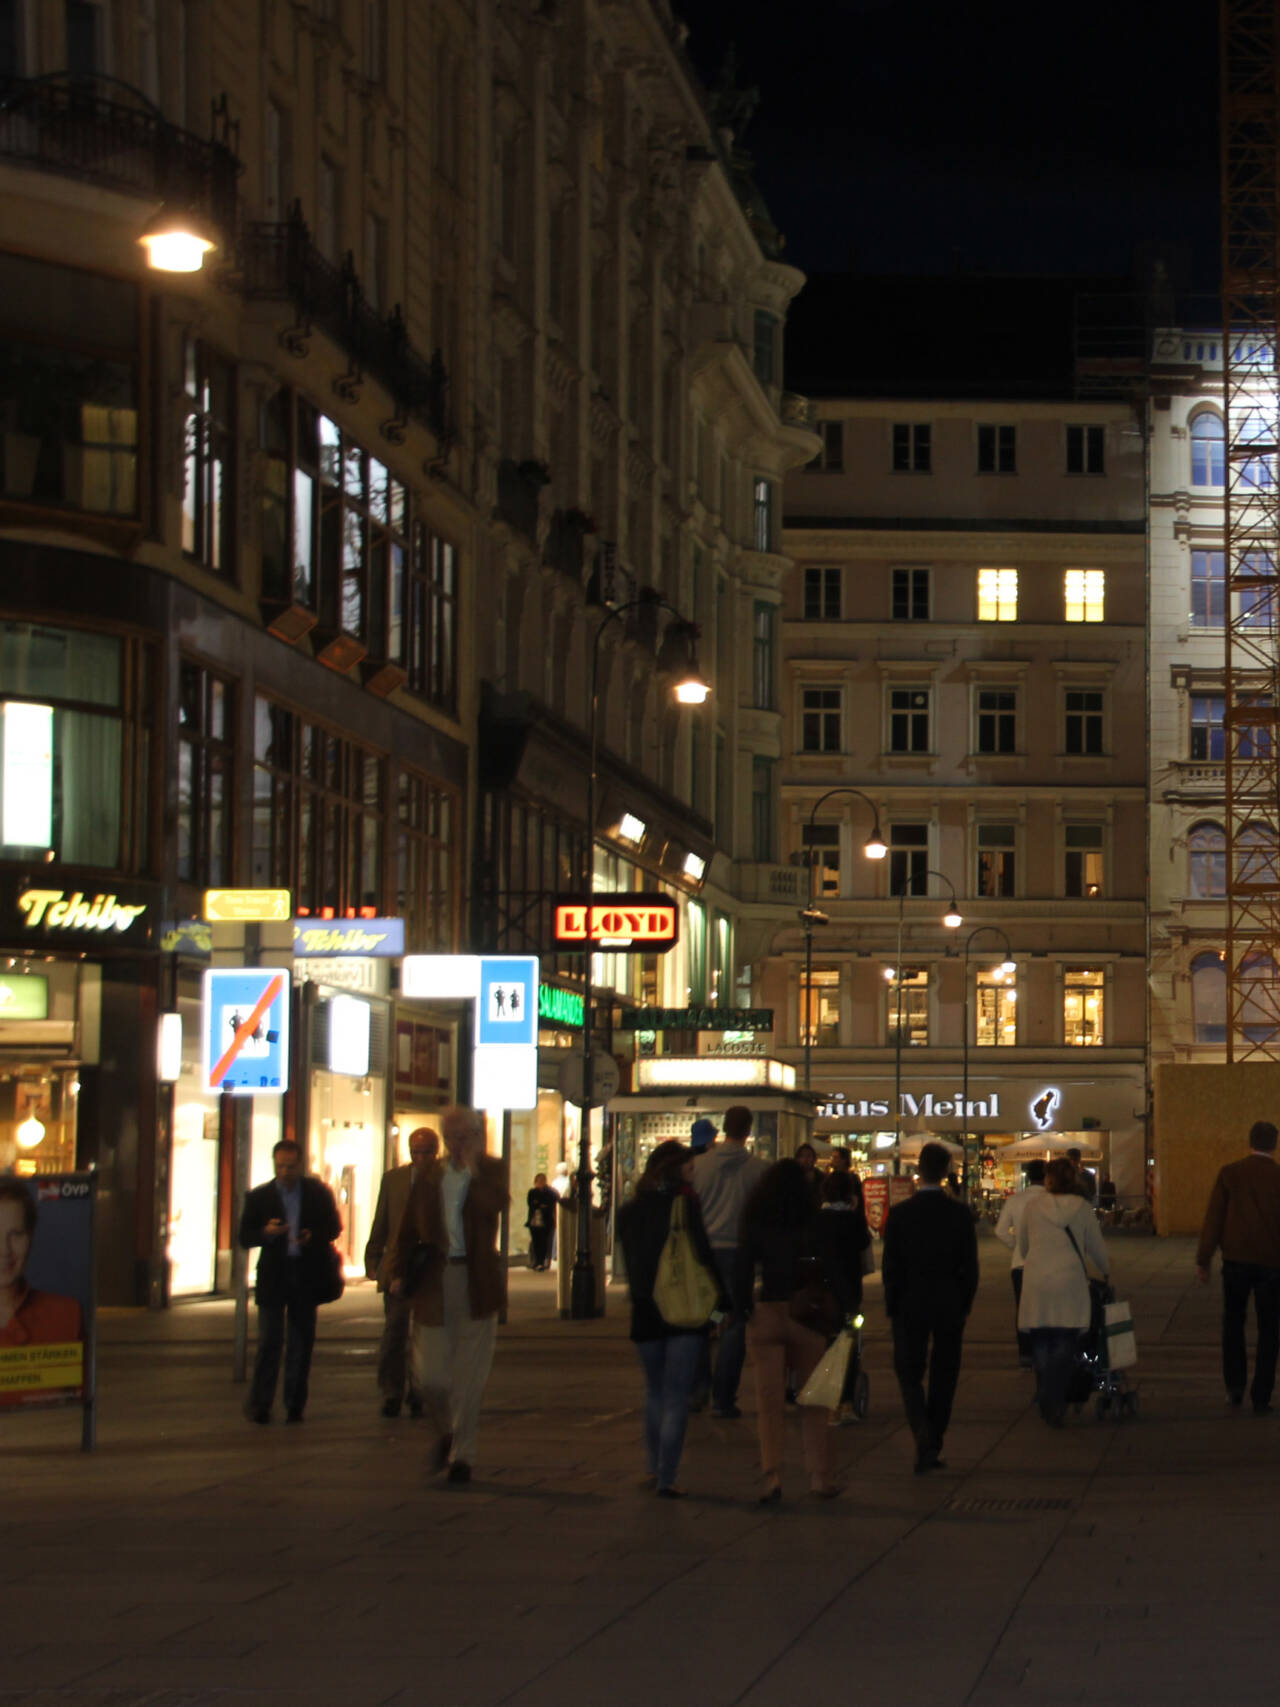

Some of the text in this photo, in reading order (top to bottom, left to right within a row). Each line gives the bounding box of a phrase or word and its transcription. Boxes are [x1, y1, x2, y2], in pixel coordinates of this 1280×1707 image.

[18, 889, 147, 932] Tchibo
[564, 912, 669, 933] LLOYD
[301, 928, 388, 952] Tchibo
[706, 1043, 768, 1056] LACOSTE
[899, 1093, 999, 1117] Meinl
[62, 1182, 89, 1197] ÖVP
